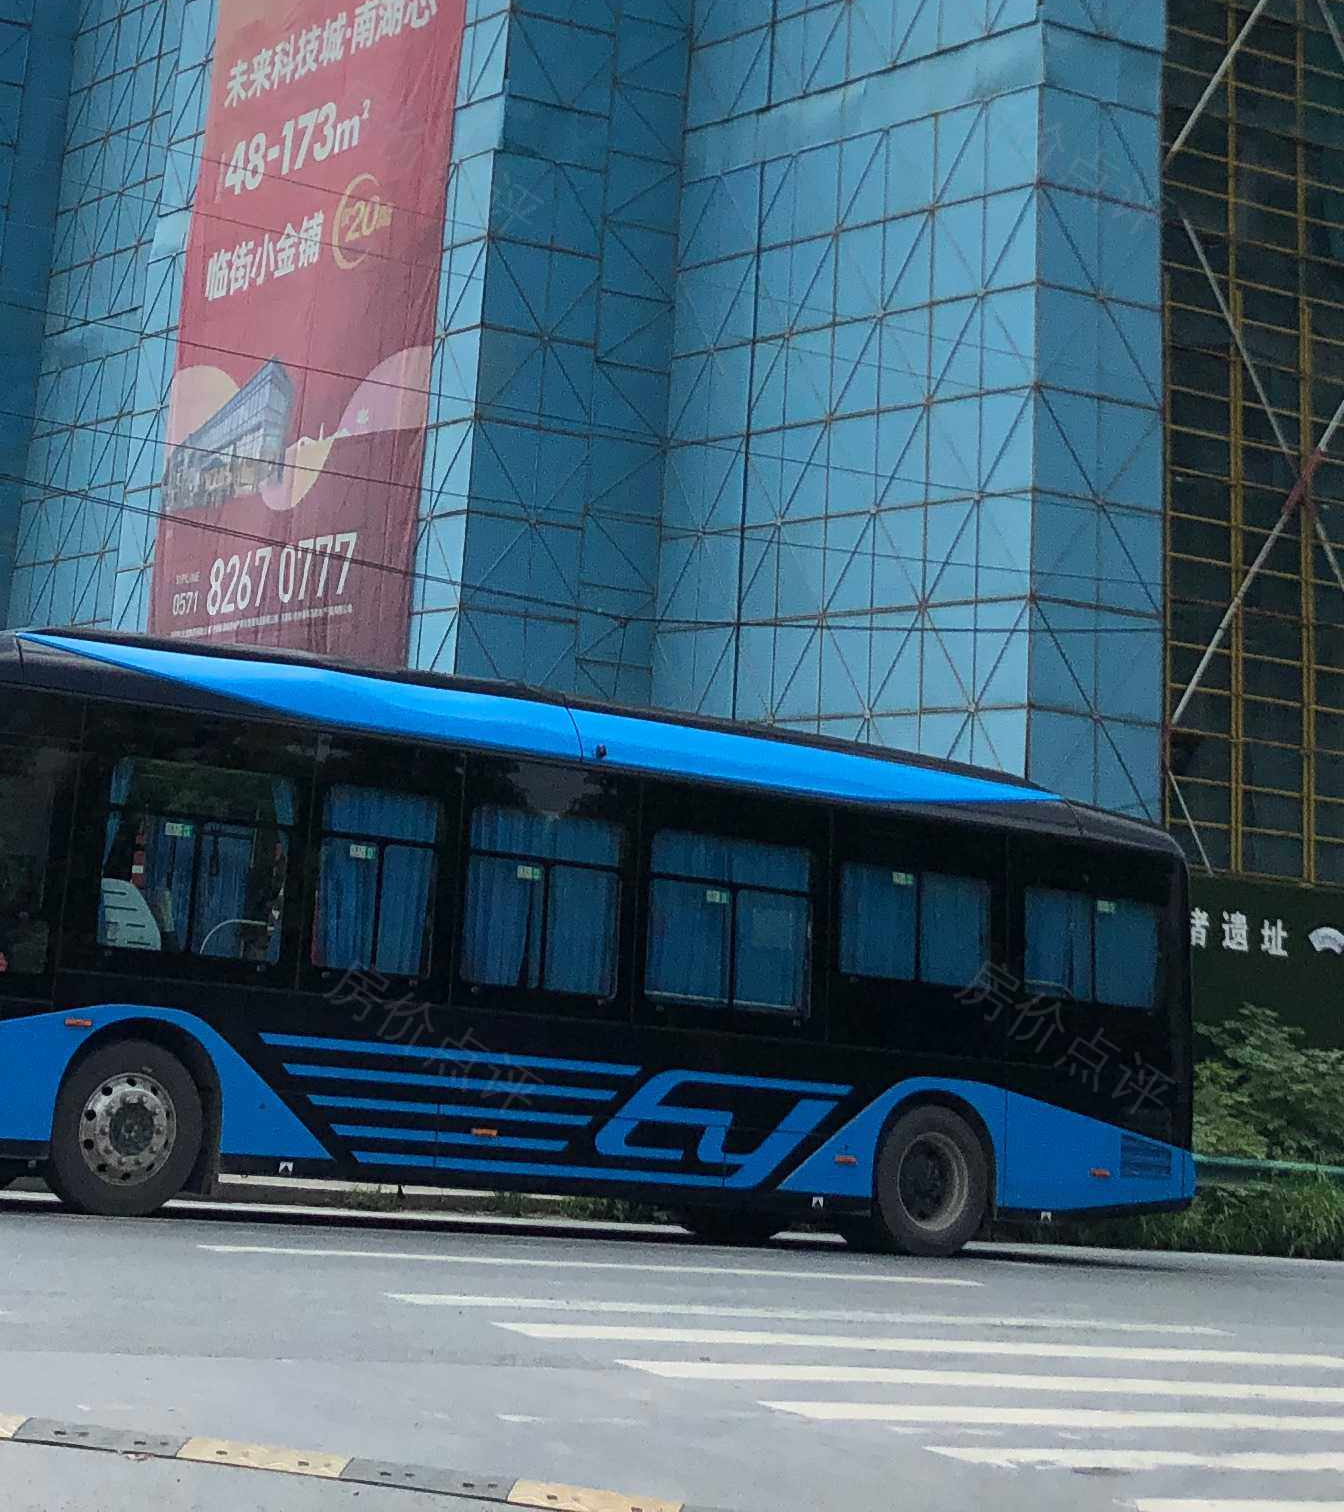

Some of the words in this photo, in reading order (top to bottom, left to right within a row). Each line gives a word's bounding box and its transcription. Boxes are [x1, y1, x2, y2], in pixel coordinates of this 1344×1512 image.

[172, 590, 199, 616] 0571
[206, 545, 272, 617] 8267
[276, 530, 358, 604] 0777
